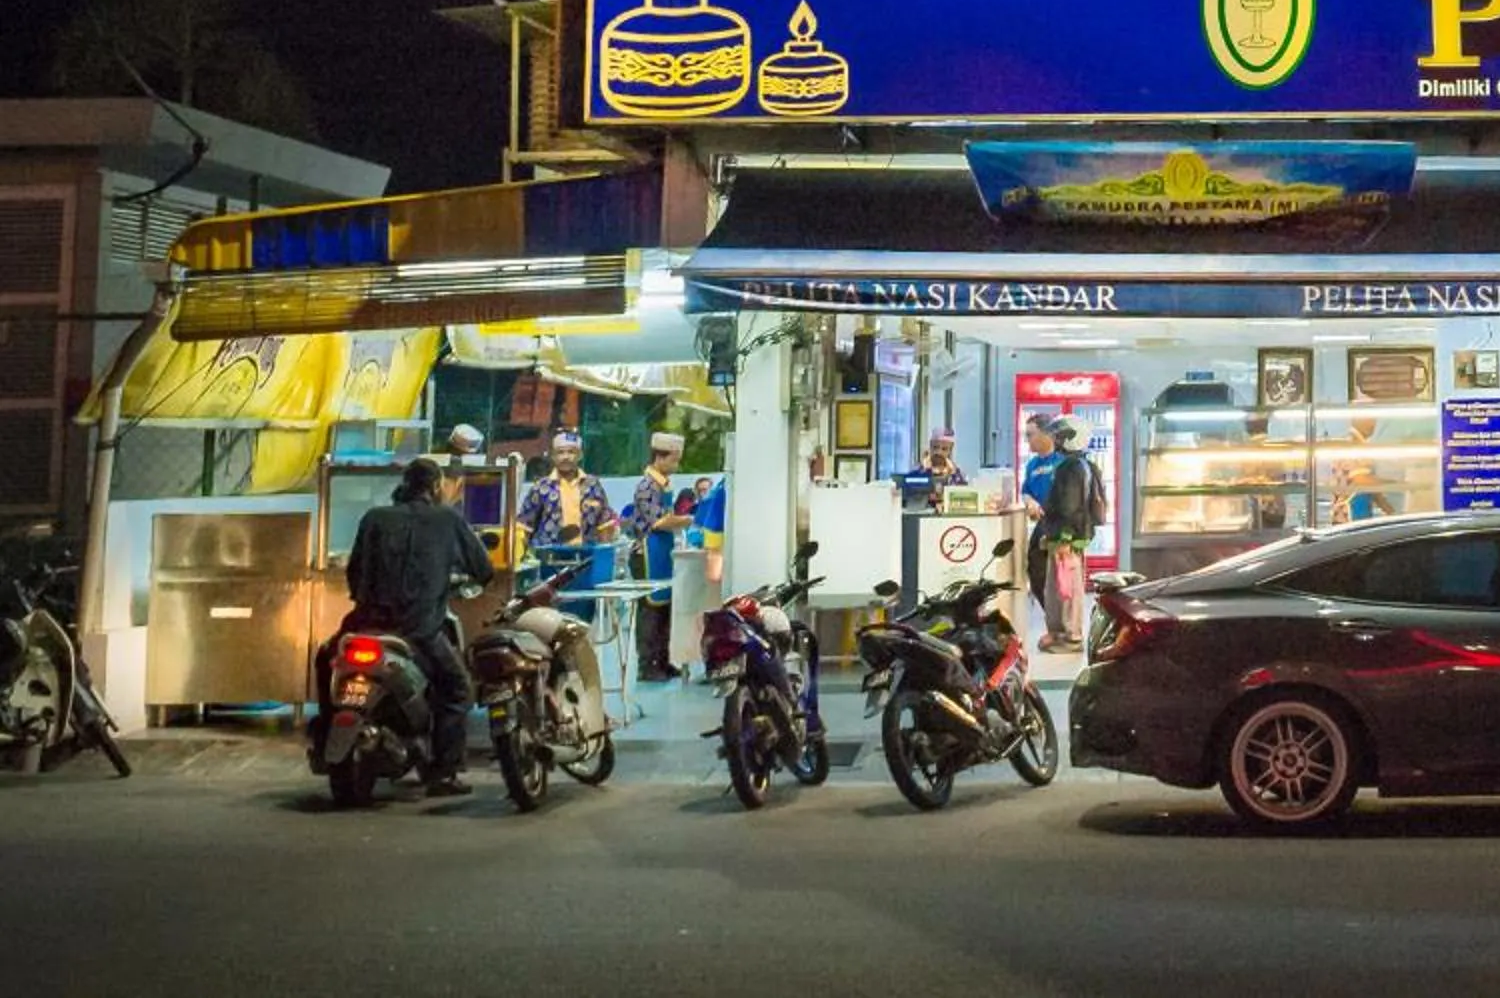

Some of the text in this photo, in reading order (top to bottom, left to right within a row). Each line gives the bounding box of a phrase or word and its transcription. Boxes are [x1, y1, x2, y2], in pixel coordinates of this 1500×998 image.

[1418, 79, 1491, 97] Dimiliki
[873, 283, 956, 310] NASI
[967, 284, 1118, 311] KANDAR
[1303, 286, 1413, 312] PELITA
